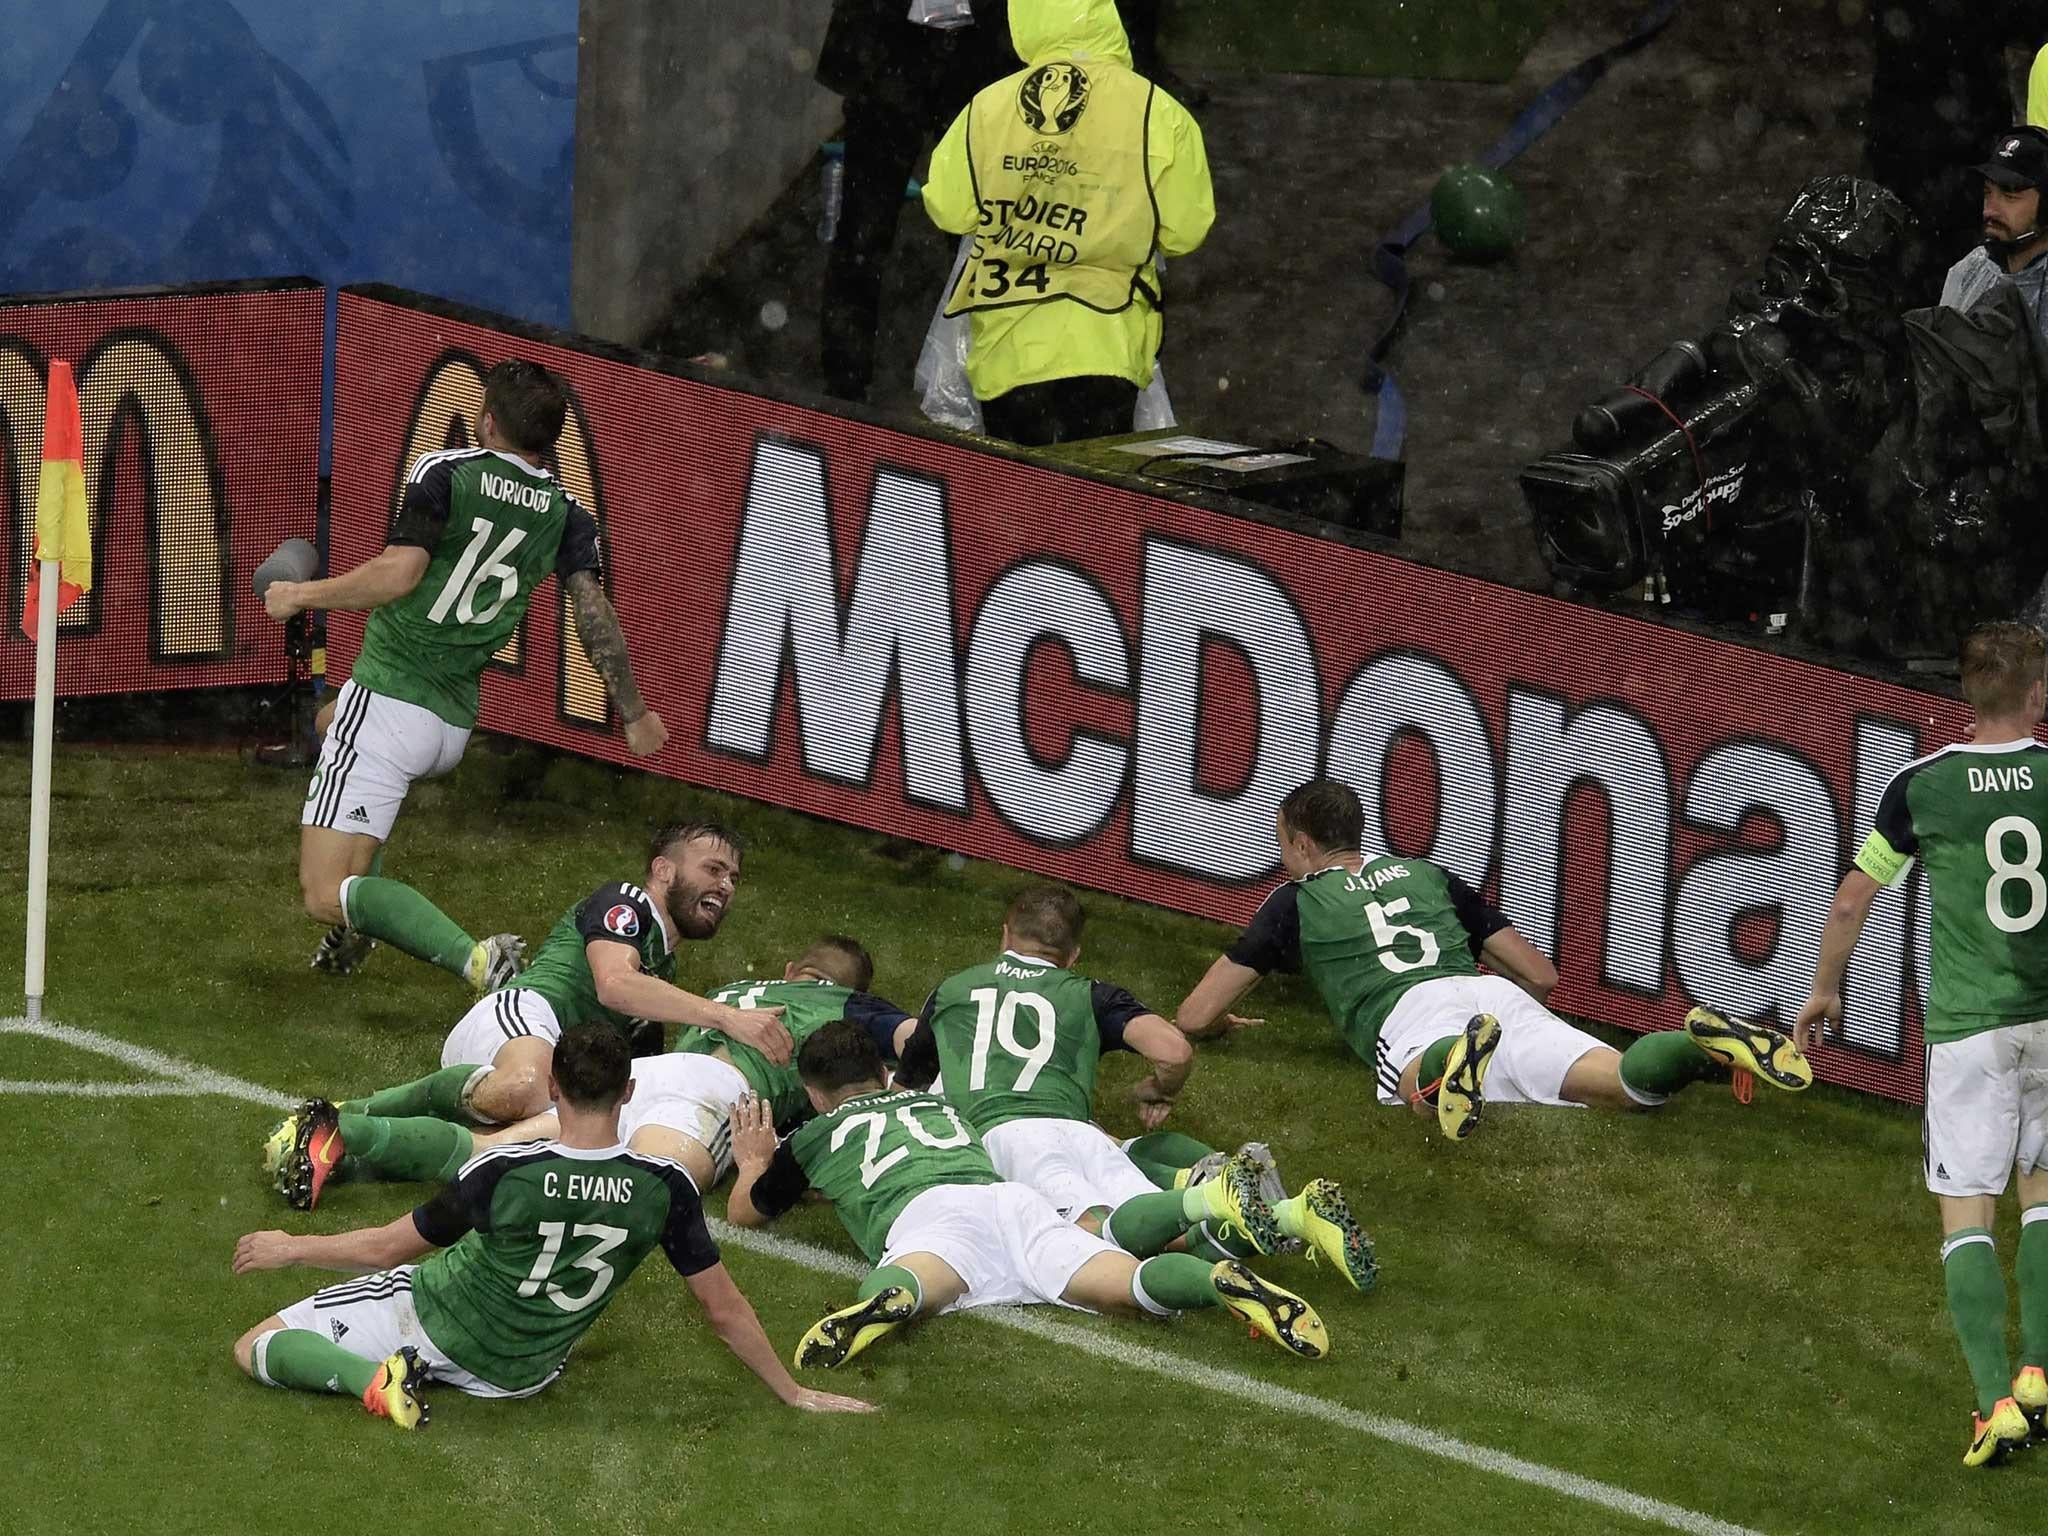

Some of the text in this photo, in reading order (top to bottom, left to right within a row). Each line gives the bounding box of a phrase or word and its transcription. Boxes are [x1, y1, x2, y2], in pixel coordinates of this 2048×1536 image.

[427, 517, 528, 624] 16
[1968, 766, 2033, 792] DAVIS
[1985, 815, 2047, 933] 8
[995, 961, 1047, 980] WARD
[1363, 896, 1440, 974] 5
[969, 987, 1056, 1092] 19
[543, 1171, 633, 1203] C. EVANS
[830, 1101, 971, 1190] 20
[517, 1221, 628, 1312] 13
